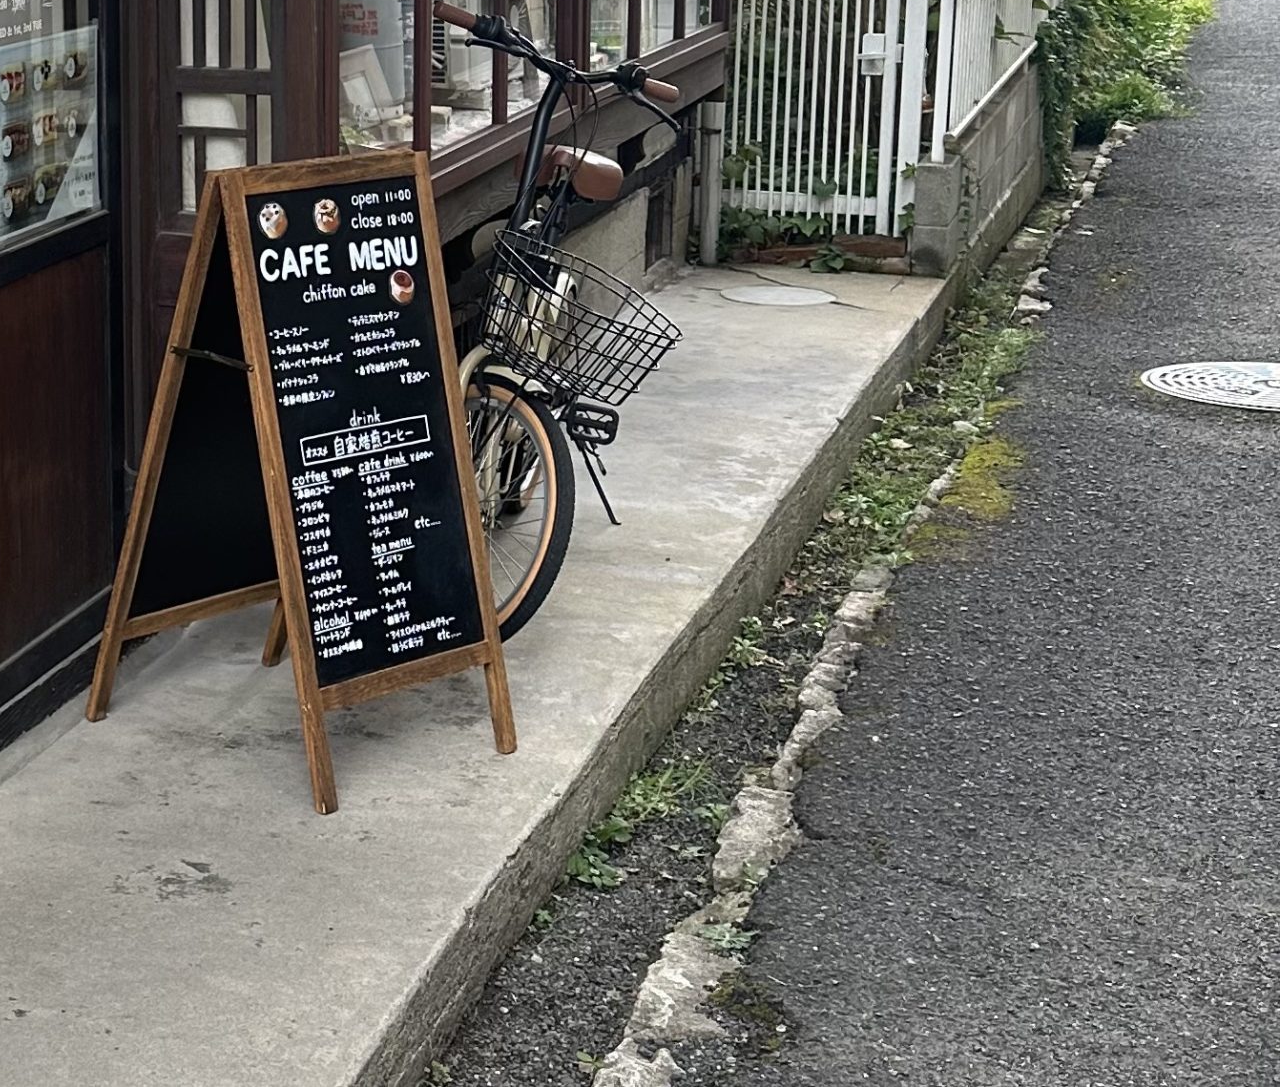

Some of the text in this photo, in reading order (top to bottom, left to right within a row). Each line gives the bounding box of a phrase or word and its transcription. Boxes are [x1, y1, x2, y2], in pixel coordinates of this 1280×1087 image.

[351, 189, 411, 210] open 11:00
[351, 212, 414, 229] close 18:00
[259, 235, 418, 282] CAFE MENU
[302, 279, 376, 304] chiffon cake
[349, 406, 381, 427] drink
[334, 428, 414, 457] 自家焙煎コーヒー
[358, 458, 381, 472] cafe
[384, 451, 406, 467] drink
[292, 471, 328, 487] coffee
[371, 537, 412, 554] tea menu
[314, 610, 350, 632] alcohol
